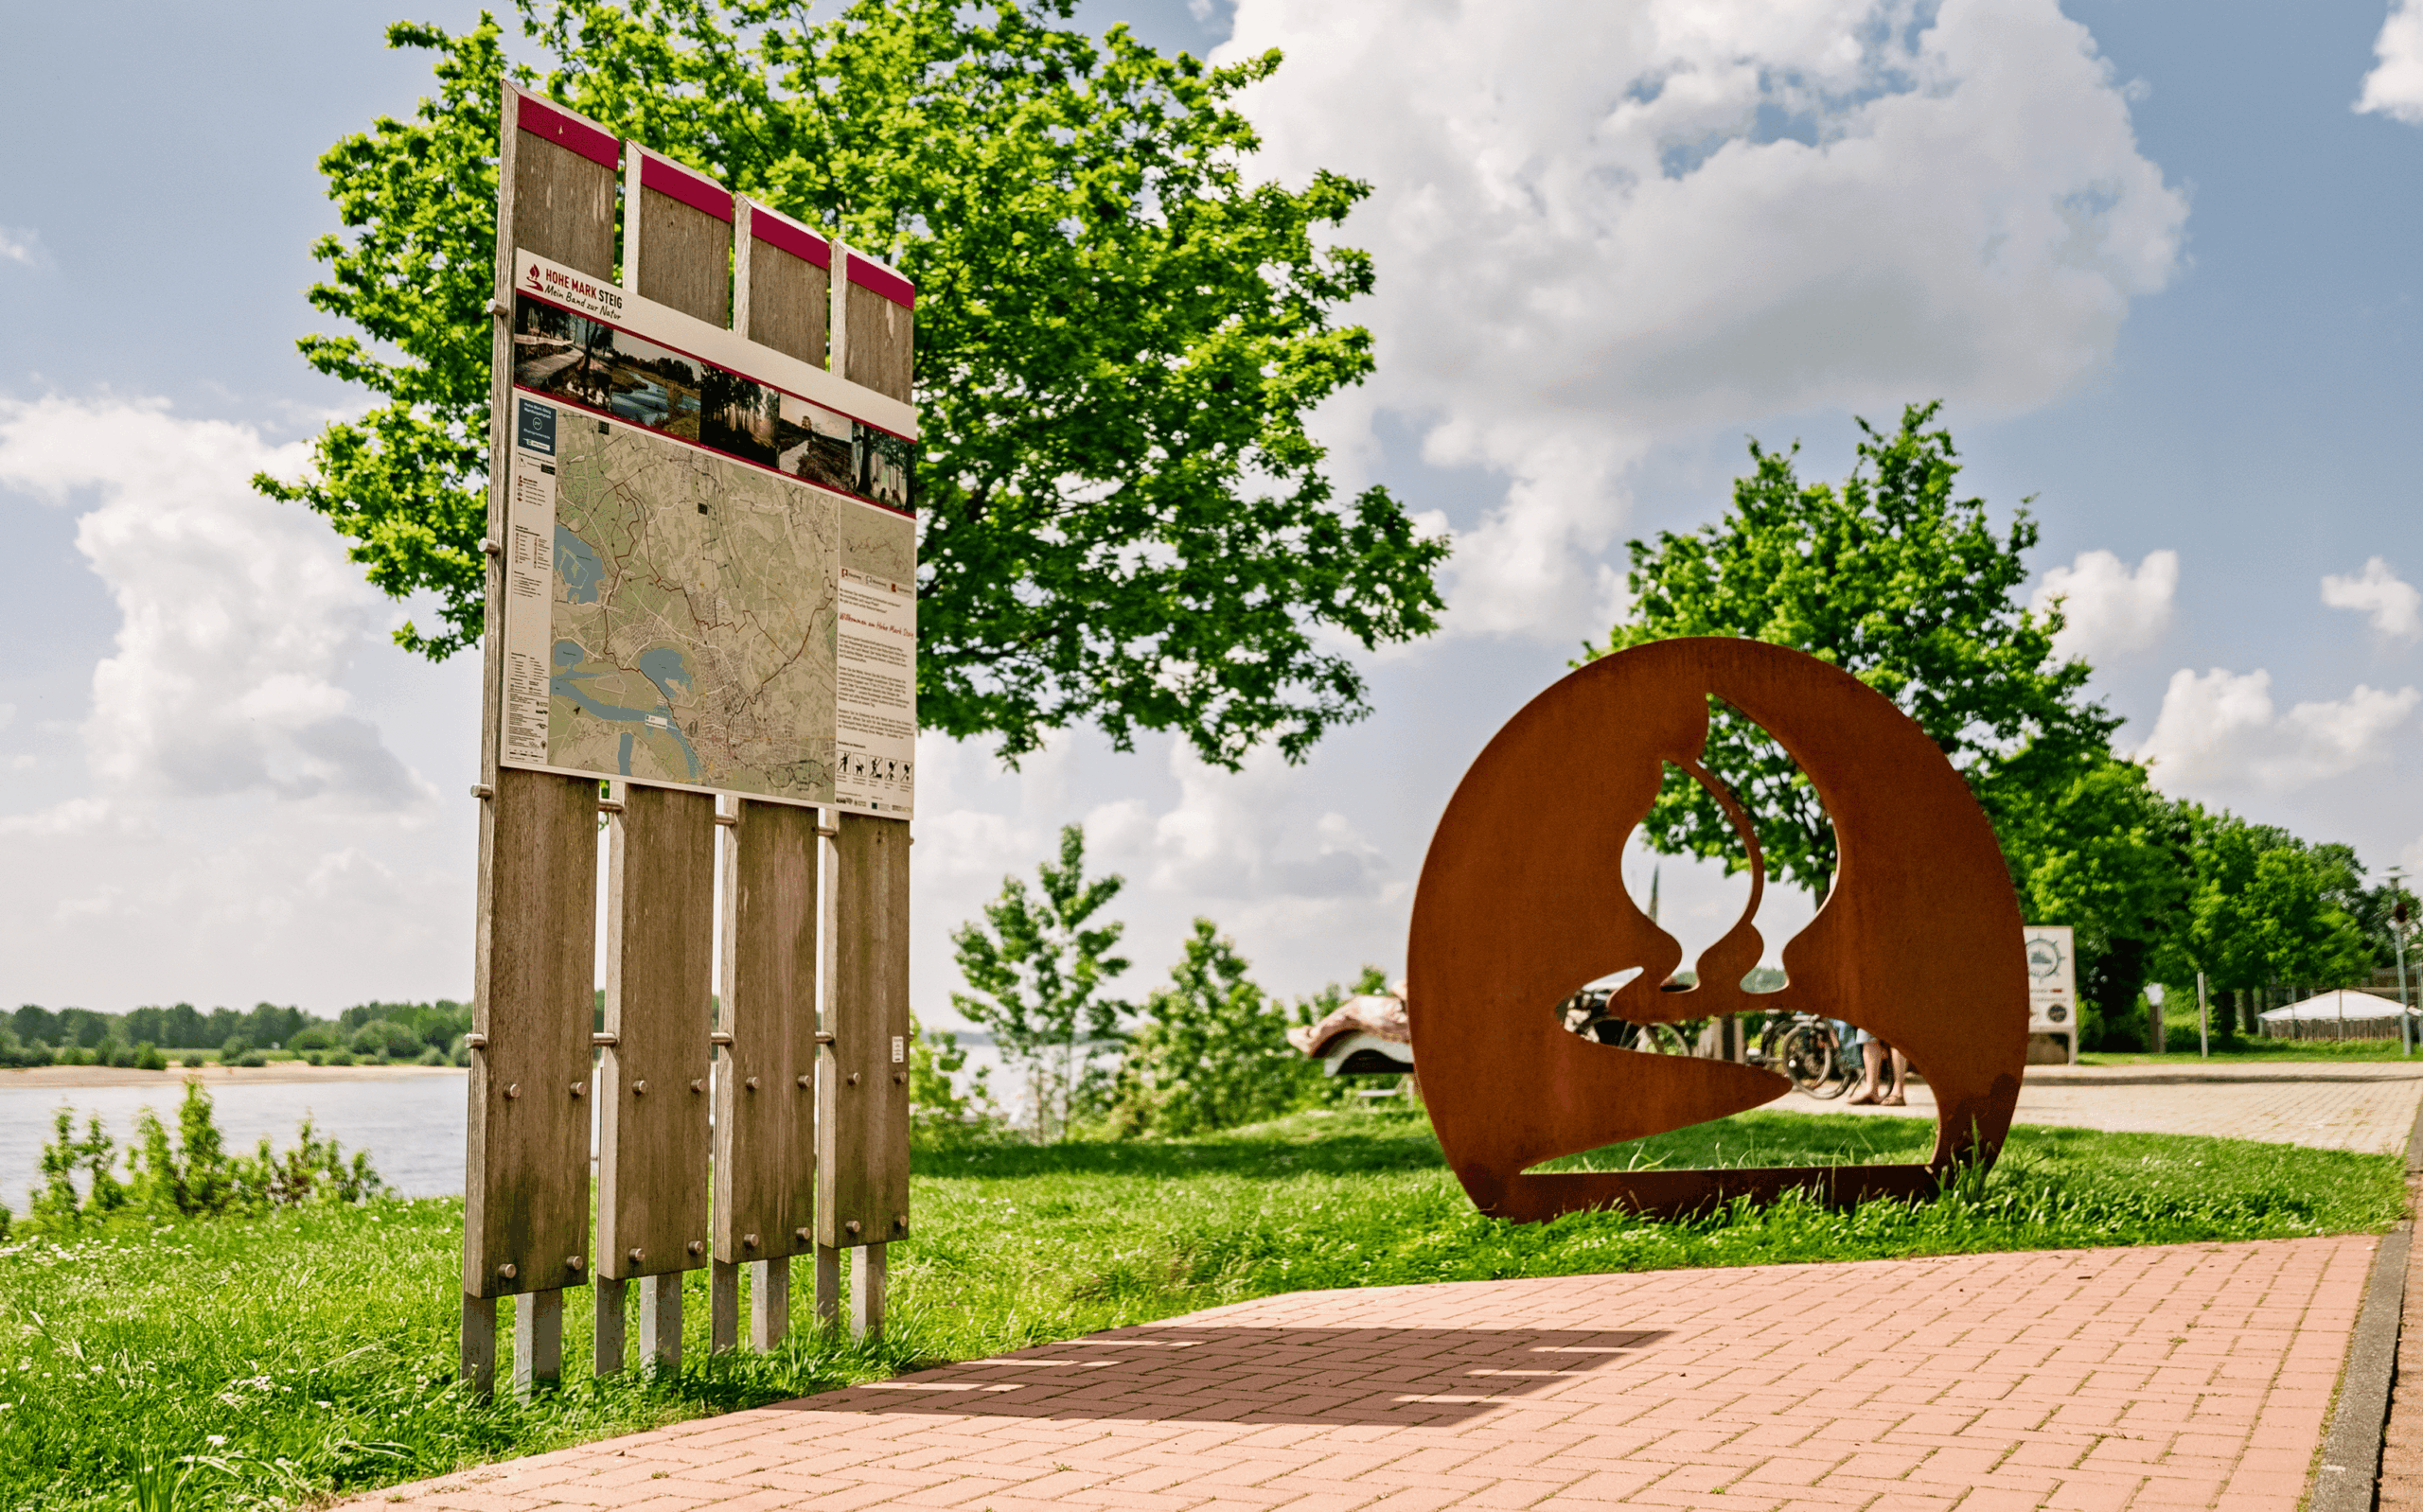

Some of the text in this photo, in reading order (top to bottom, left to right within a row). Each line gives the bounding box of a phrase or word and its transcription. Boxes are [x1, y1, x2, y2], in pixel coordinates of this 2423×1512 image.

[544, 284, 622, 320] Mein Band zur Natur
[546, 269, 623, 309] HOHE MARK STEIG
[840, 613, 866, 624] Willkommen
